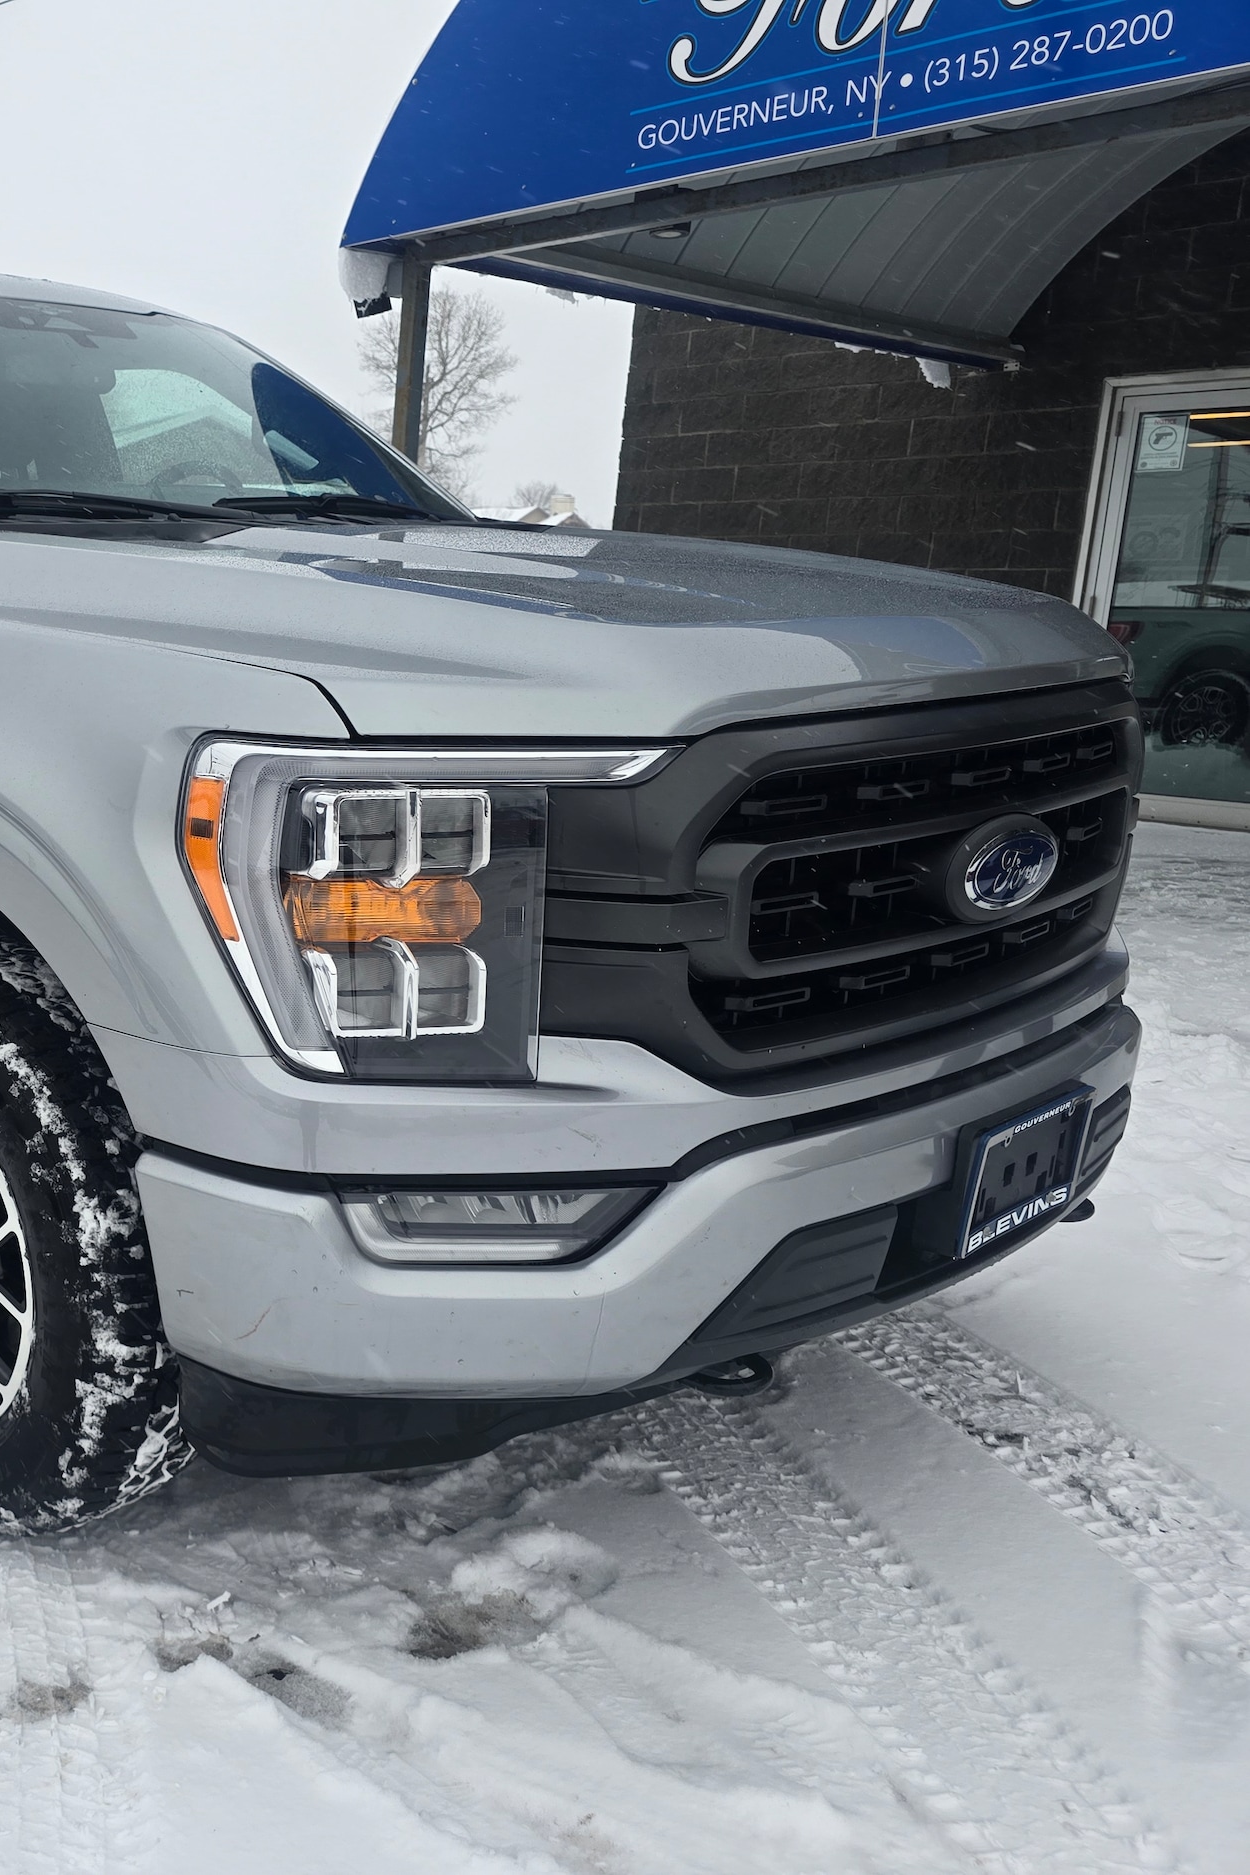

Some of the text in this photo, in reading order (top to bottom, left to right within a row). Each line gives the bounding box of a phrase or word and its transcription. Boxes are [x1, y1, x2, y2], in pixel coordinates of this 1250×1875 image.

[637, 9, 1174, 151] GOUVERNEUR, NY (315) 287-0200
[993, 847, 1044, 893] Ford
[1014, 1101, 1071, 1134] GOUVERNEUR
[967, 1188, 1067, 1253] BLEVINS
